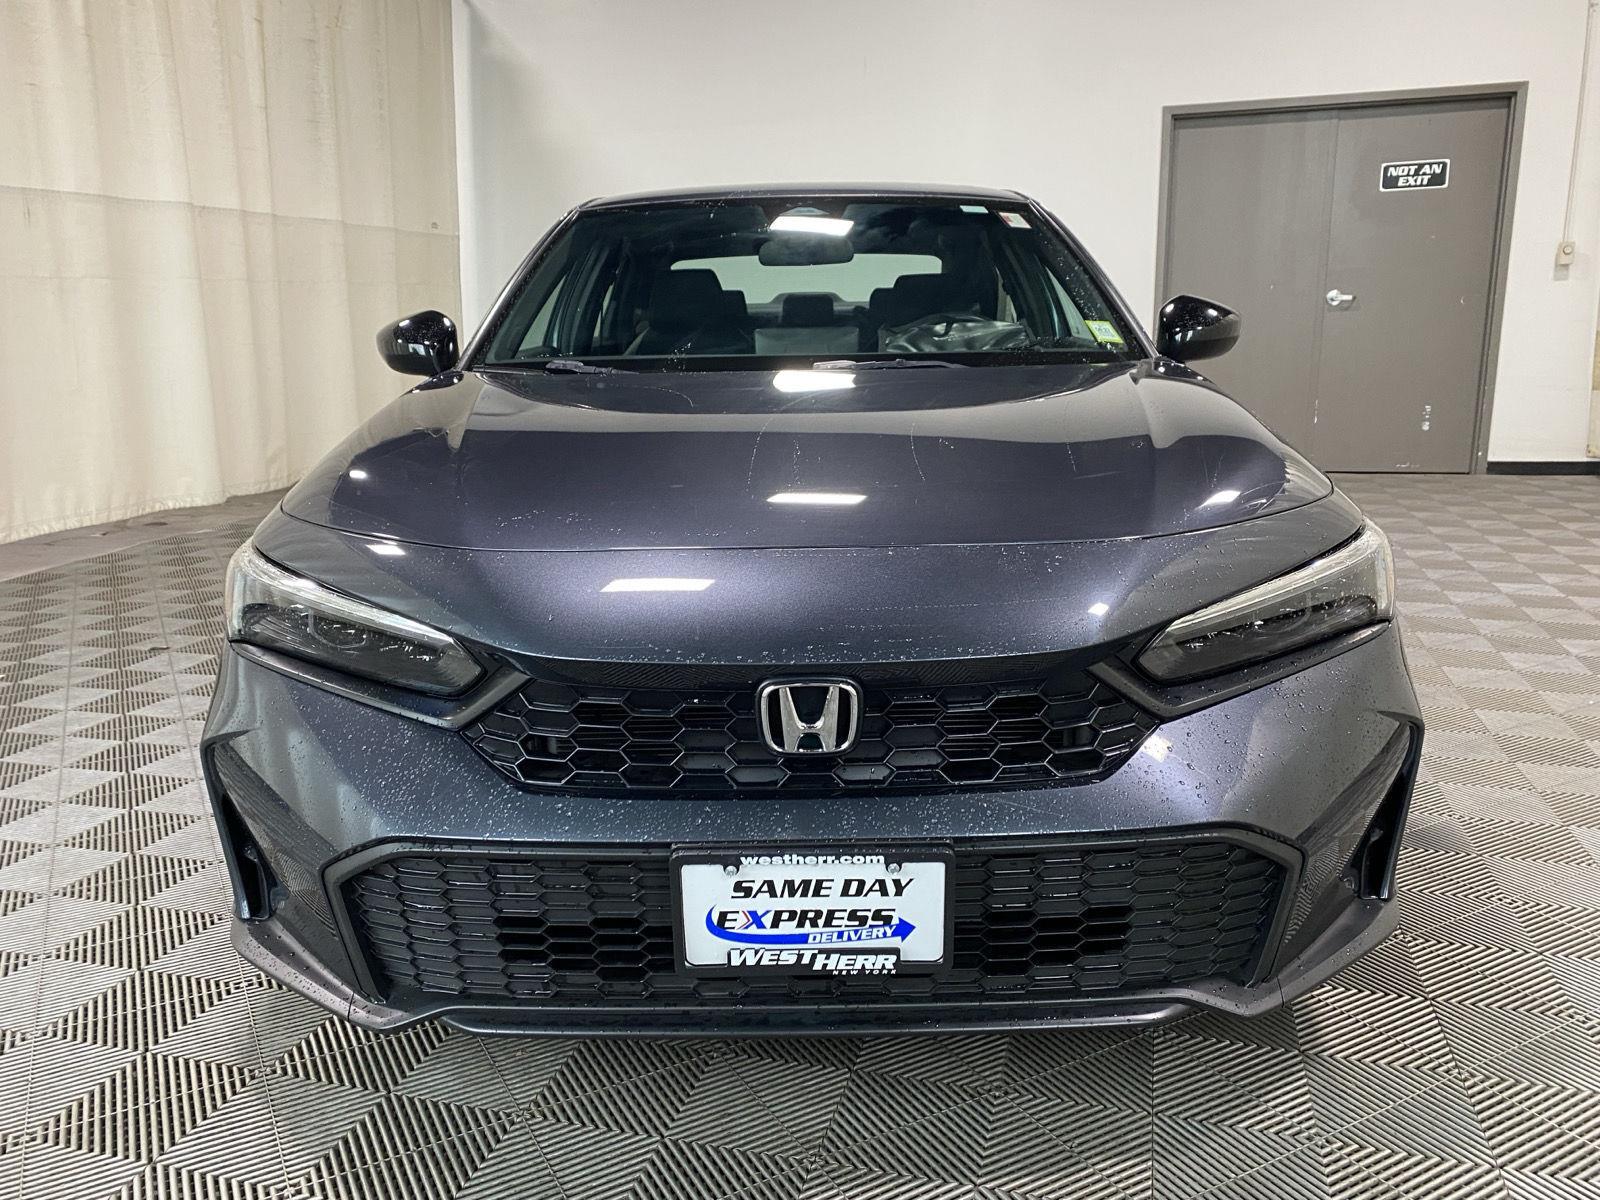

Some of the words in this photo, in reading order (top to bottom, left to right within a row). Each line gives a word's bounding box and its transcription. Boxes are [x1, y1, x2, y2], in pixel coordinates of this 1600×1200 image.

[1387, 165, 1418, 177] NOT
[1419, 163, 1443, 175] AN
[1397, 174, 1431, 187] EXIT
[740, 854, 885, 866] westherr.com
[731, 878, 834, 899] SAME
[840, 878, 914, 898] DAY
[716, 909, 896, 930] EXPRESS
[807, 925, 897, 944] DELIVERY
